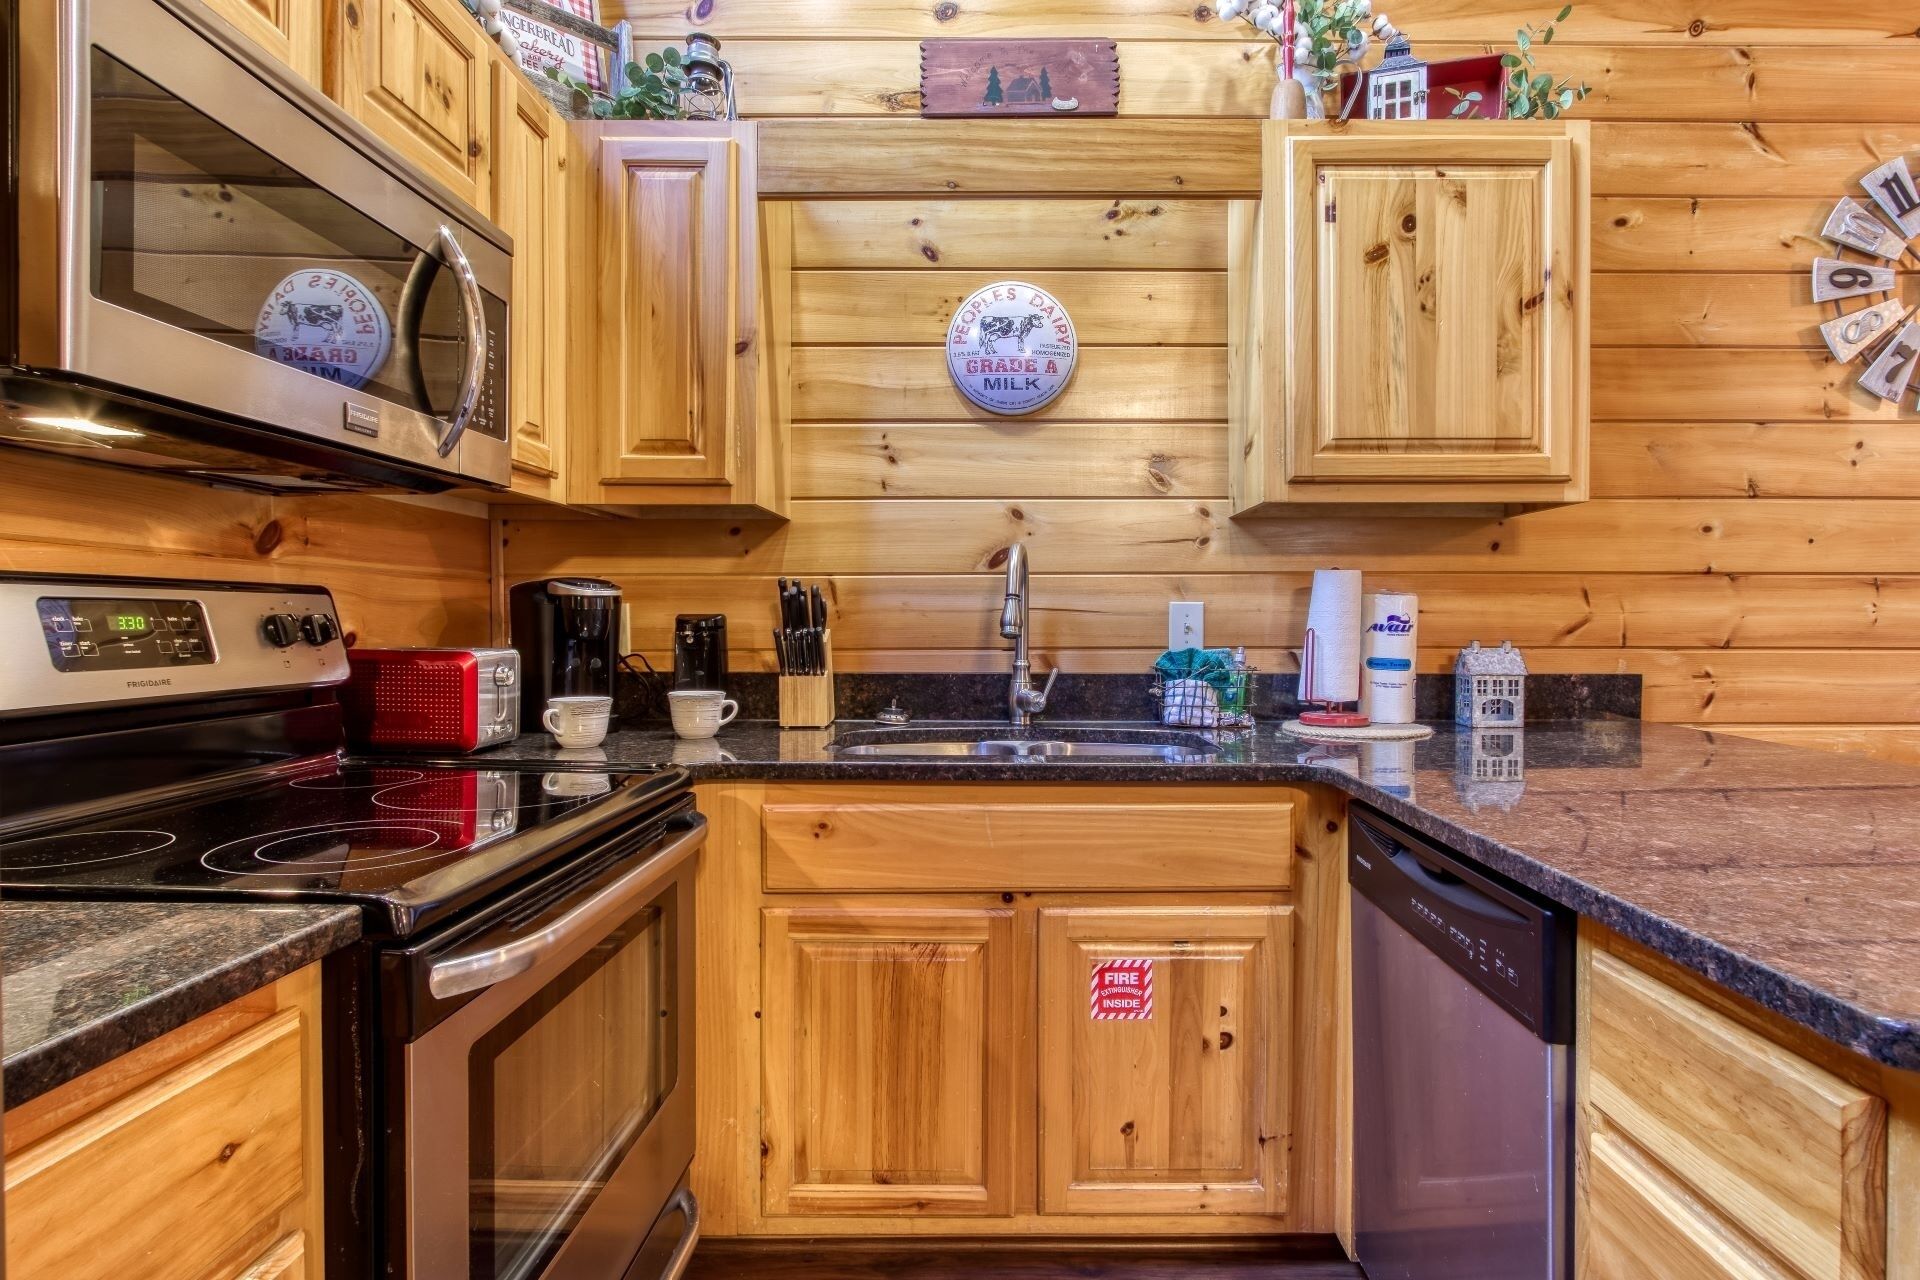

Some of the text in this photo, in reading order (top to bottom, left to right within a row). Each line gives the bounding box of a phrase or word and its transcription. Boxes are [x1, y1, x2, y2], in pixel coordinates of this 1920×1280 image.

[500, 11, 575, 57] NGERBREAD
[522, 58, 539, 71] FEE
[1839, 212, 1886, 252] 10
[953, 288, 1071, 345] PEOPLES DAIRY
[1841, 310, 1884, 344] 8
[1031, 350, 1071, 358] HOMOGENIZED
[966, 358, 1058, 374] GRADE A
[1885, 340, 1918, 383] 7
[983, 377, 1041, 391] MILK
[118, 616, 145, 630] 3:30
[127, 679, 171, 688] FRIGIDAIRE
[1104, 972, 1139, 985] FIRE
[1101, 987, 1142, 996] EXTINGUISHER
[1103, 999, 1140, 1008] INSIDE
